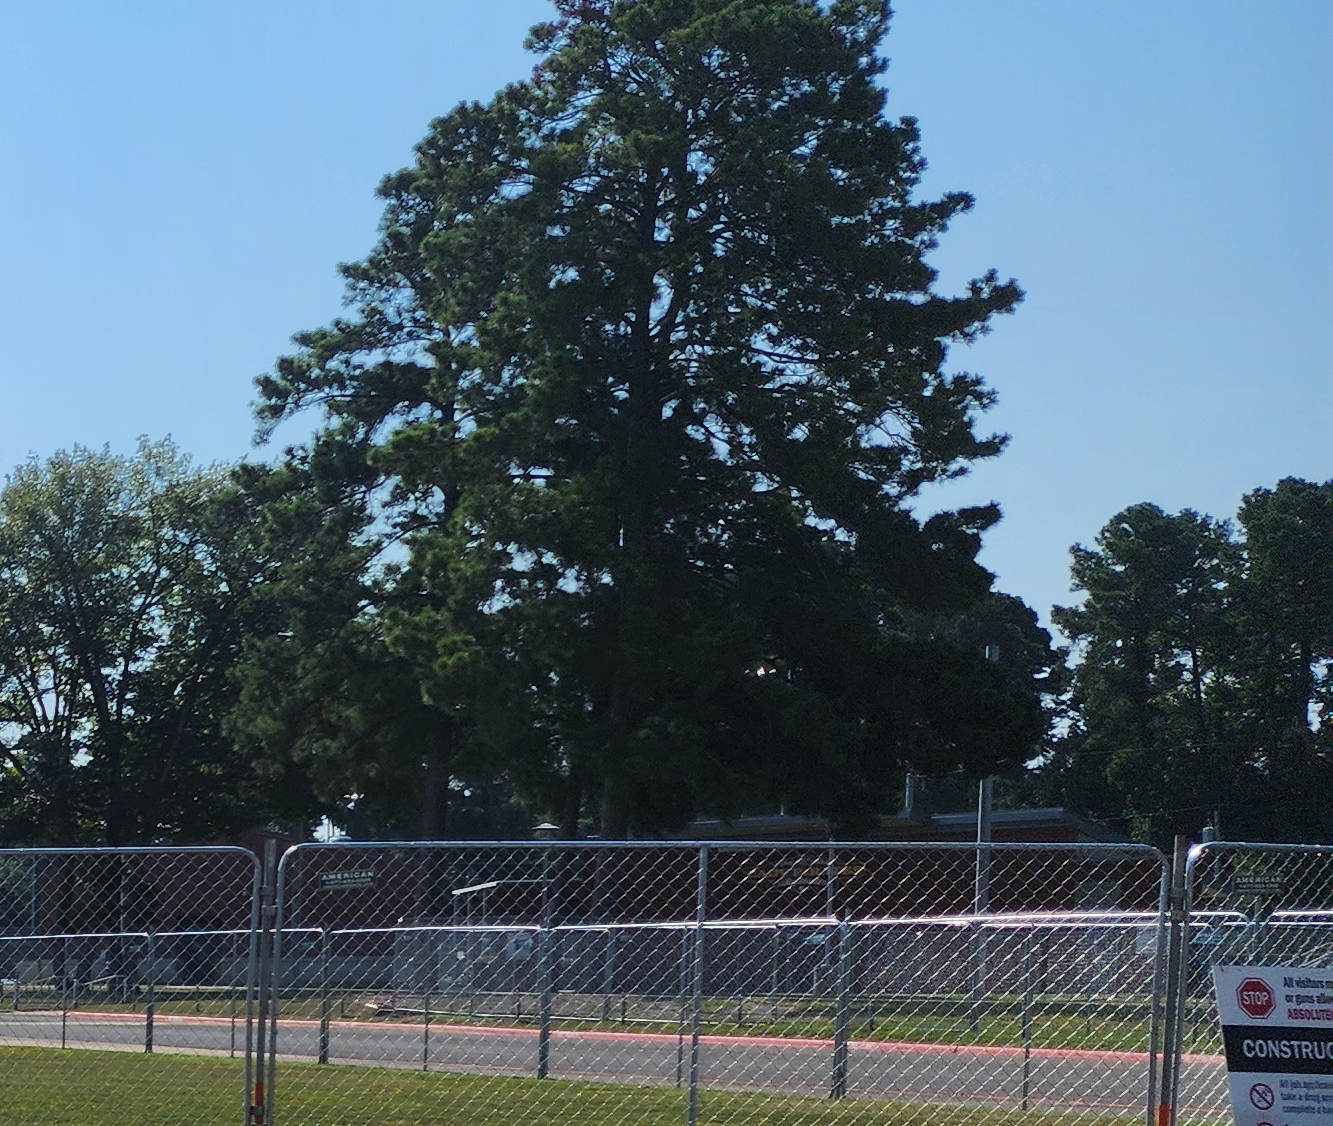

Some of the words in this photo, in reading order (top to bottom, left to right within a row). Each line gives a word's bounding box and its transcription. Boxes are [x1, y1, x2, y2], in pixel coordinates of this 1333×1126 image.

[321, 871, 374, 880] AMERICAN
[1283, 977, 1294, 988] All
[1295, 977, 1325, 988] visitors
[1242, 991, 1269, 1005] STOP
[1285, 994, 1294, 1003] or
